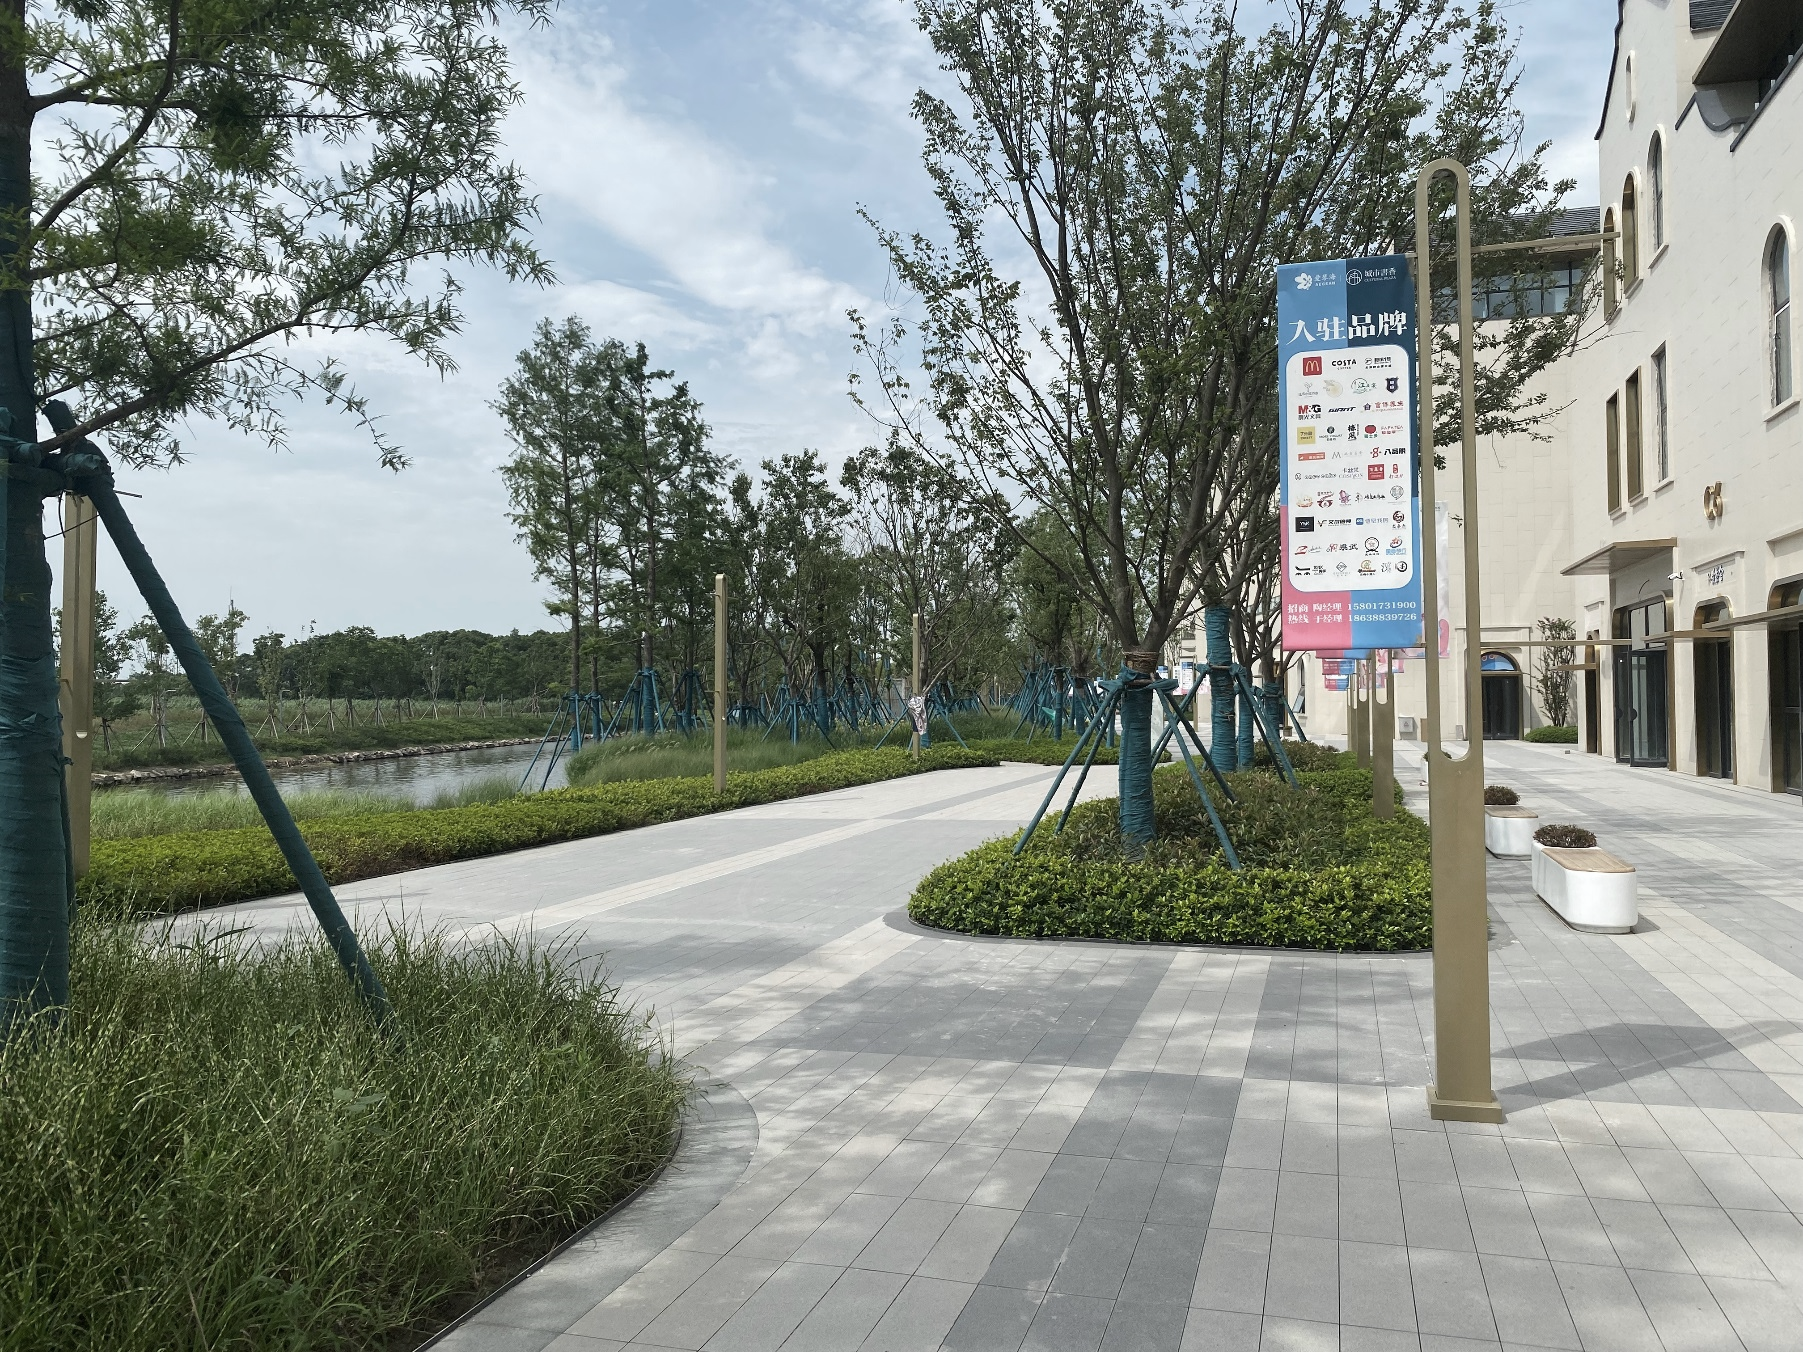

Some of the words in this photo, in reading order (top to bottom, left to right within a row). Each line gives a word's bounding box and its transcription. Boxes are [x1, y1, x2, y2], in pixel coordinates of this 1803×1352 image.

[1286, 310, 1408, 346] 入驻品牌
[1332, 359, 1357, 367] COSTA
[1288, 603, 1309, 614] 招商
[1312, 602, 1342, 612] 陶经理
[1347, 601, 1416, 611] 15801731900
[1288, 613, 1309, 624] 热线
[1348, 613, 1417, 622] 18638839726
